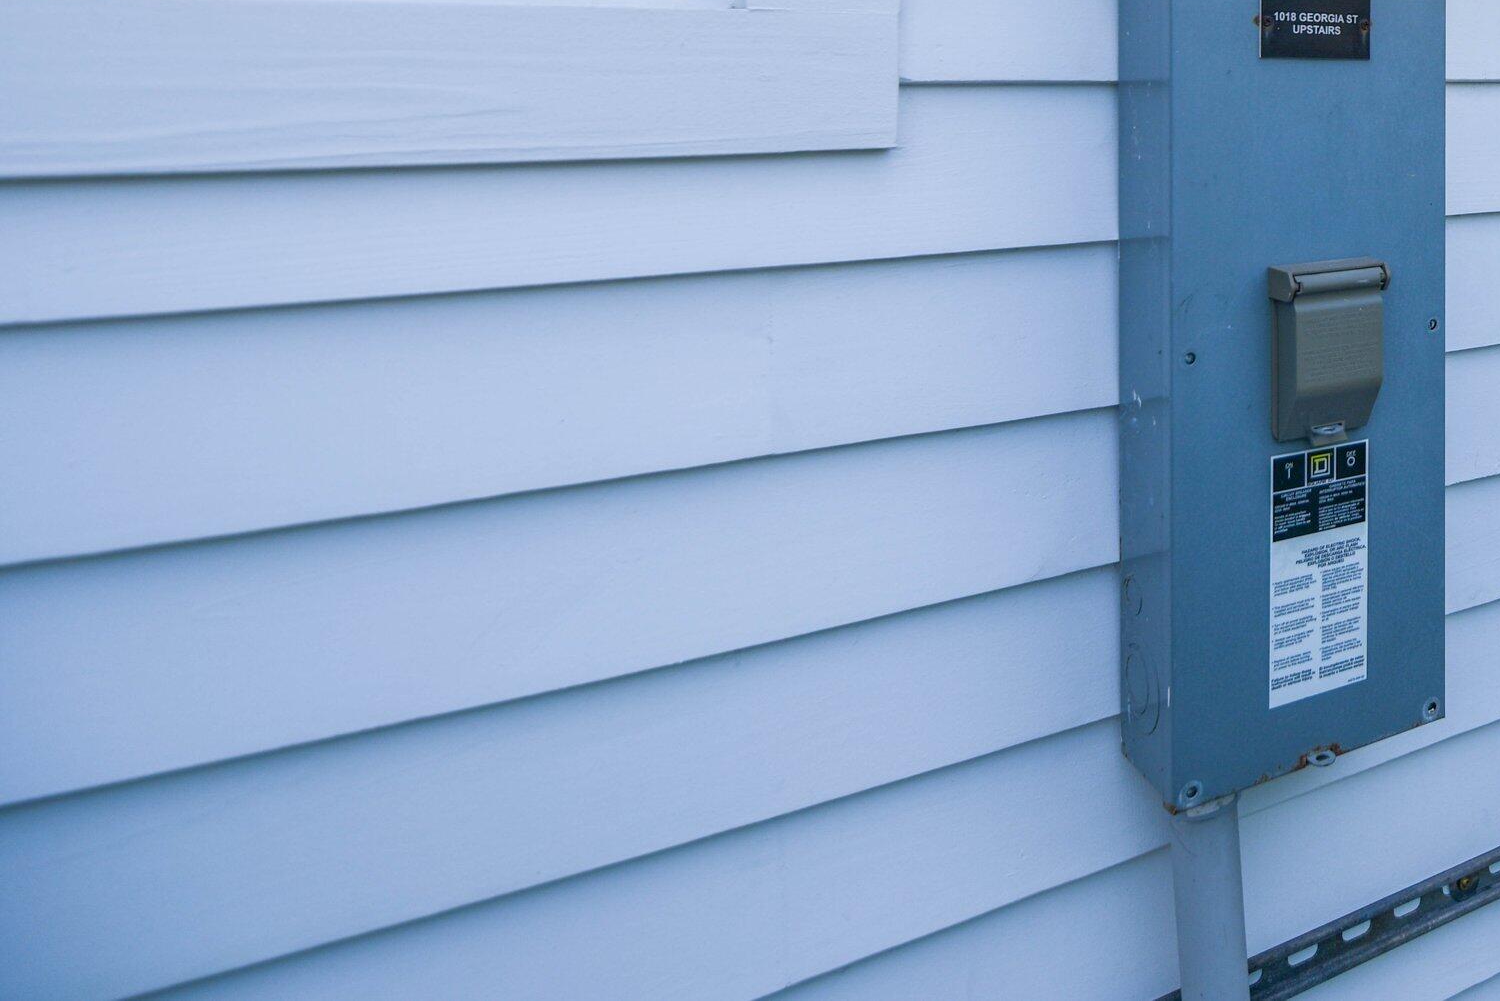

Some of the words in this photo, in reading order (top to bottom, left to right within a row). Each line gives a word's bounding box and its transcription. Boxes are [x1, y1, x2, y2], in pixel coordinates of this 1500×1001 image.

[1274, 11, 1297, 22] 1018
[1299, 12, 1345, 24] GEORGIA
[1346, 14, 1358, 24] ST
[1292, 25, 1341, 36] UPSTAIRS
